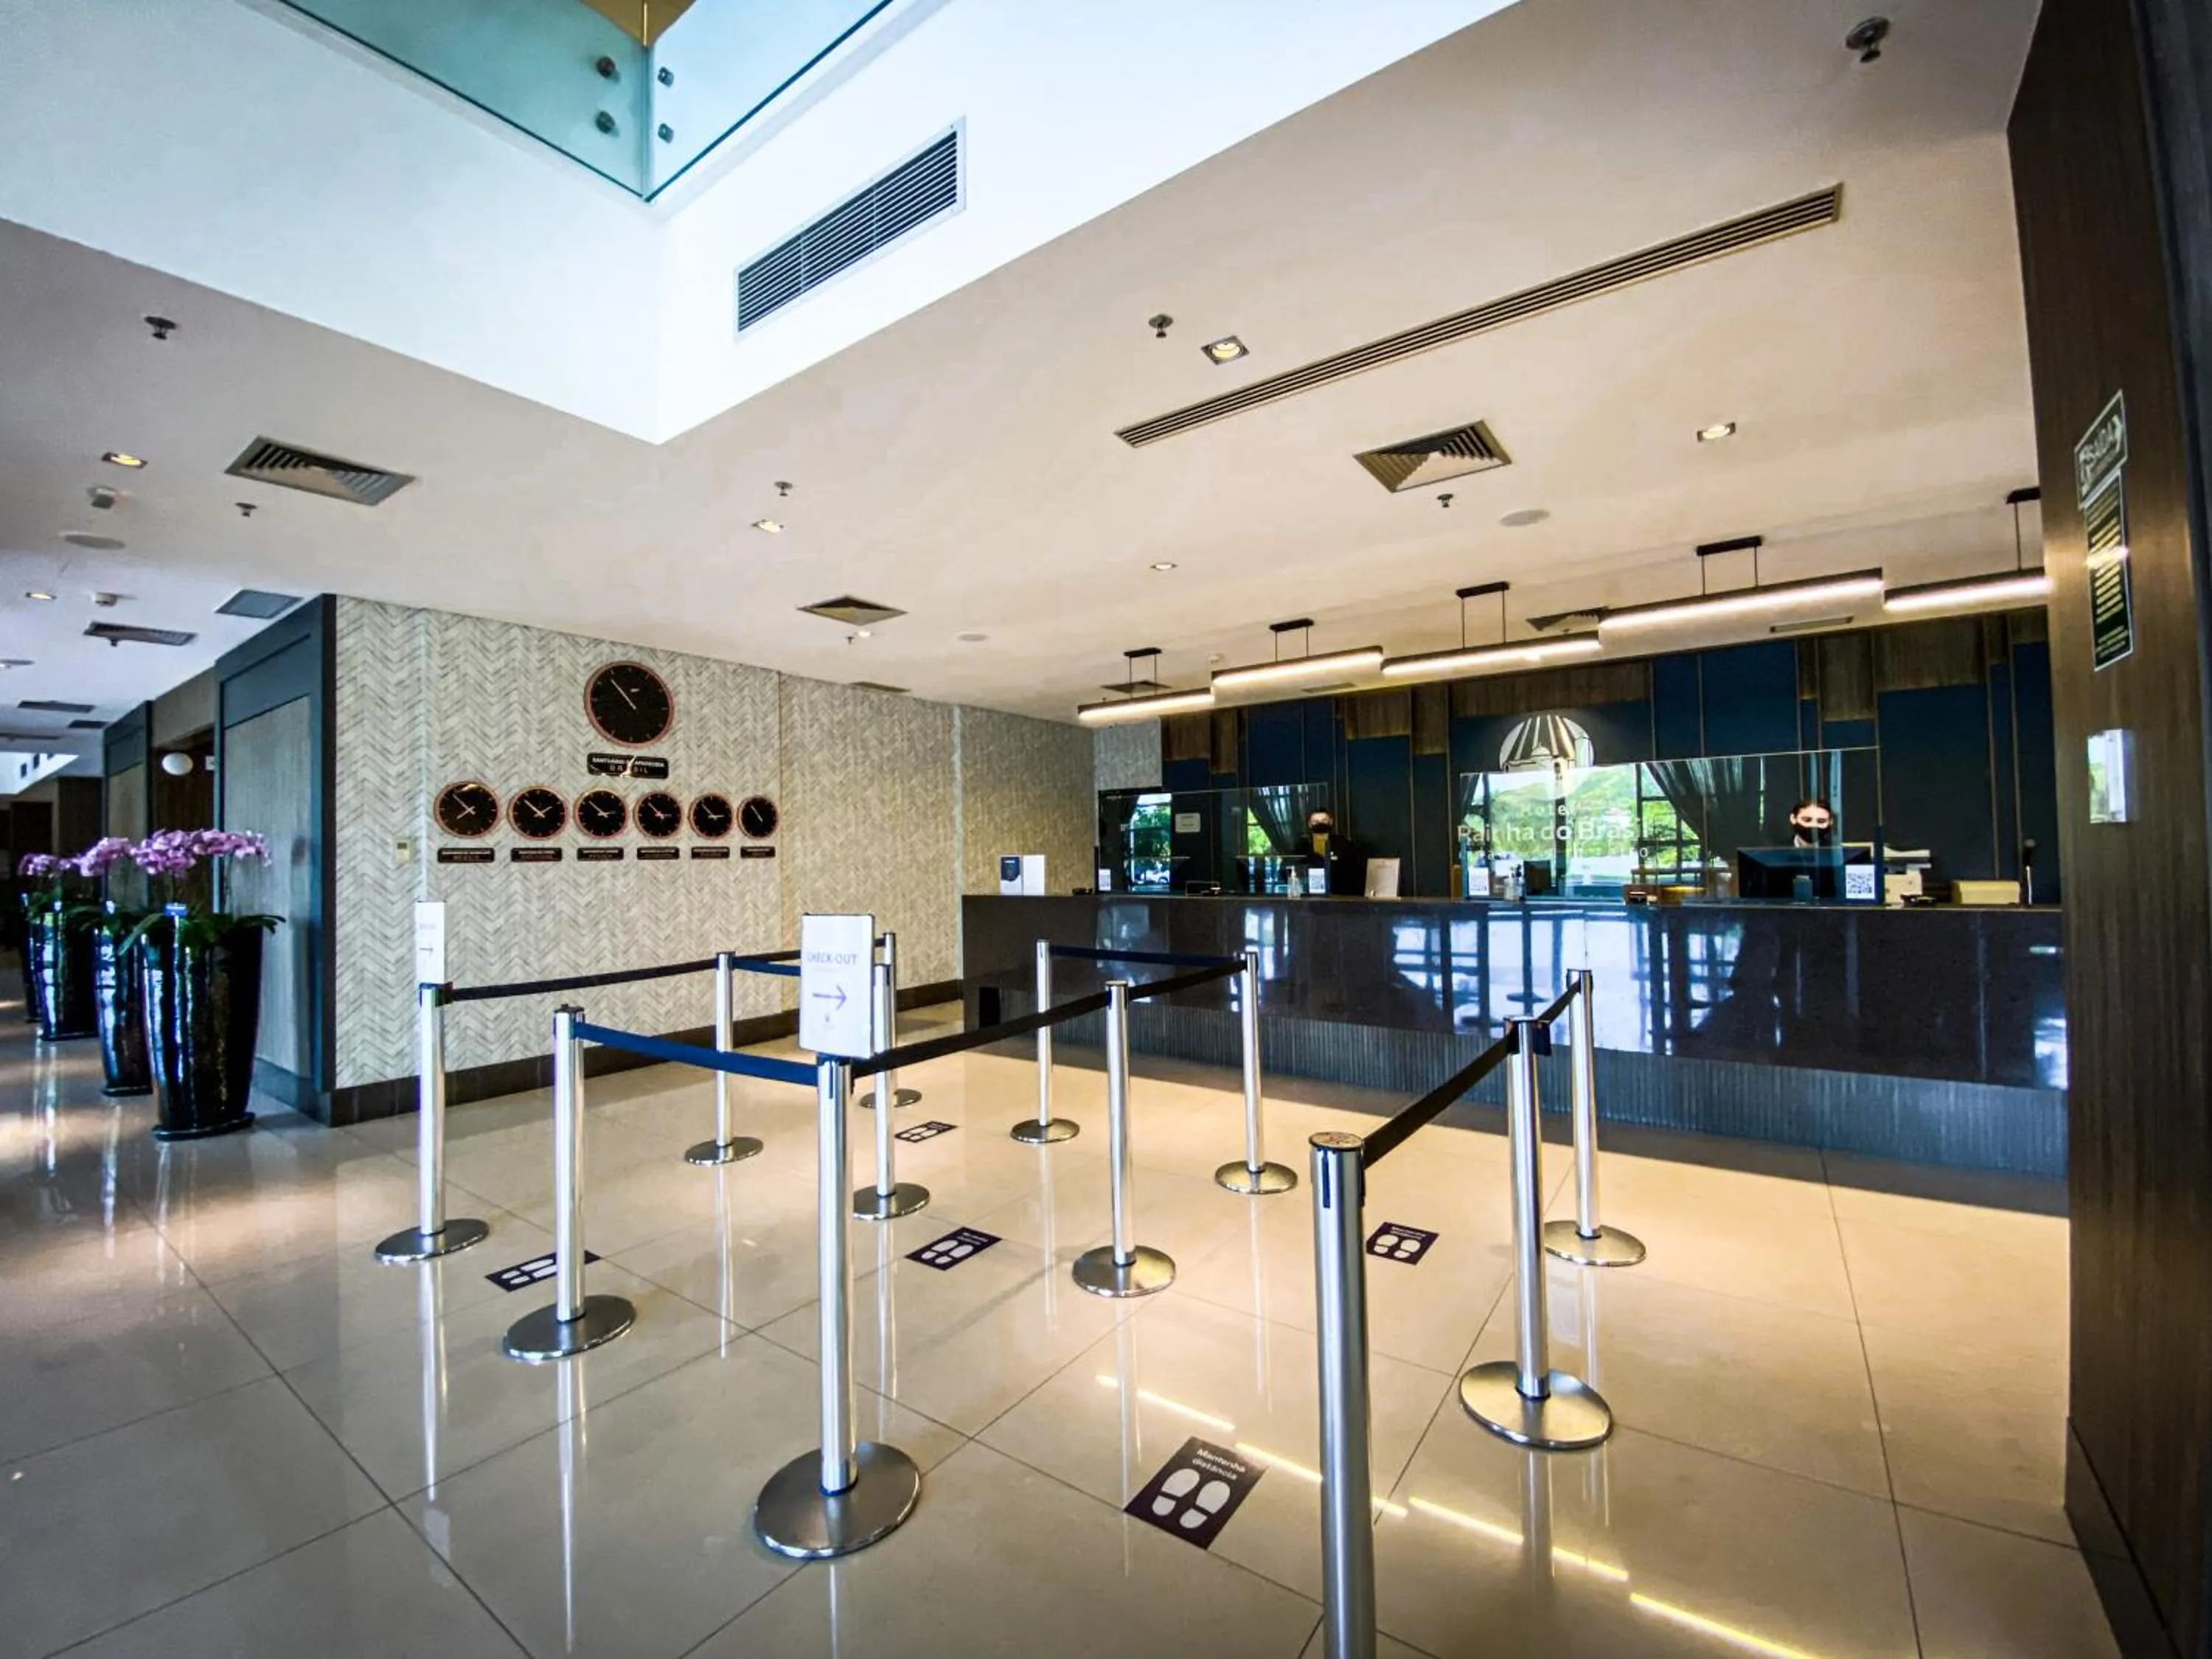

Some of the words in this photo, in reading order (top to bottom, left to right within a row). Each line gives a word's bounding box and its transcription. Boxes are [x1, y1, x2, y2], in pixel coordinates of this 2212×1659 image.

[1540, 819, 1573, 841] do
[1578, 818, 1649, 841] Brasil
[807, 950, 859, 965] CHECK-OUT
